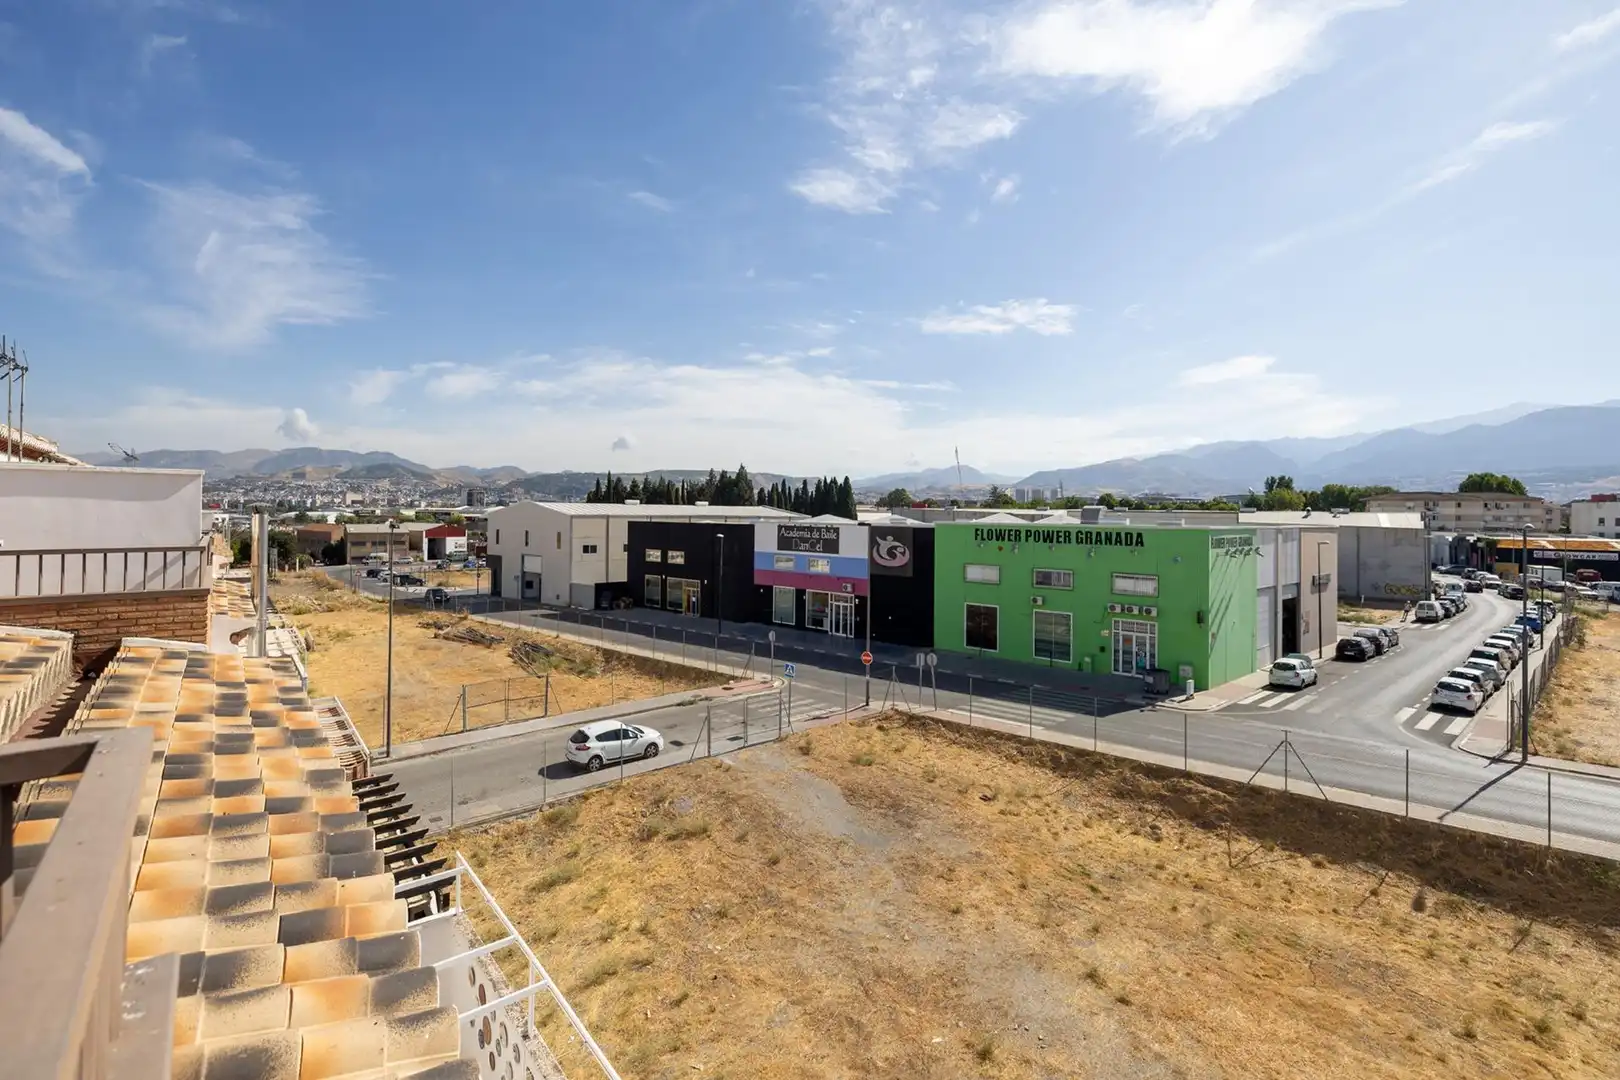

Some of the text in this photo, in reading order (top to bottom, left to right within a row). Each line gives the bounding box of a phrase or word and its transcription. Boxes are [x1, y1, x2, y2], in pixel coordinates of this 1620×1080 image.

[780, 527, 837, 540] Academia de Baile
[974, 528, 1145, 548] FLOWER POWER GRANADA
